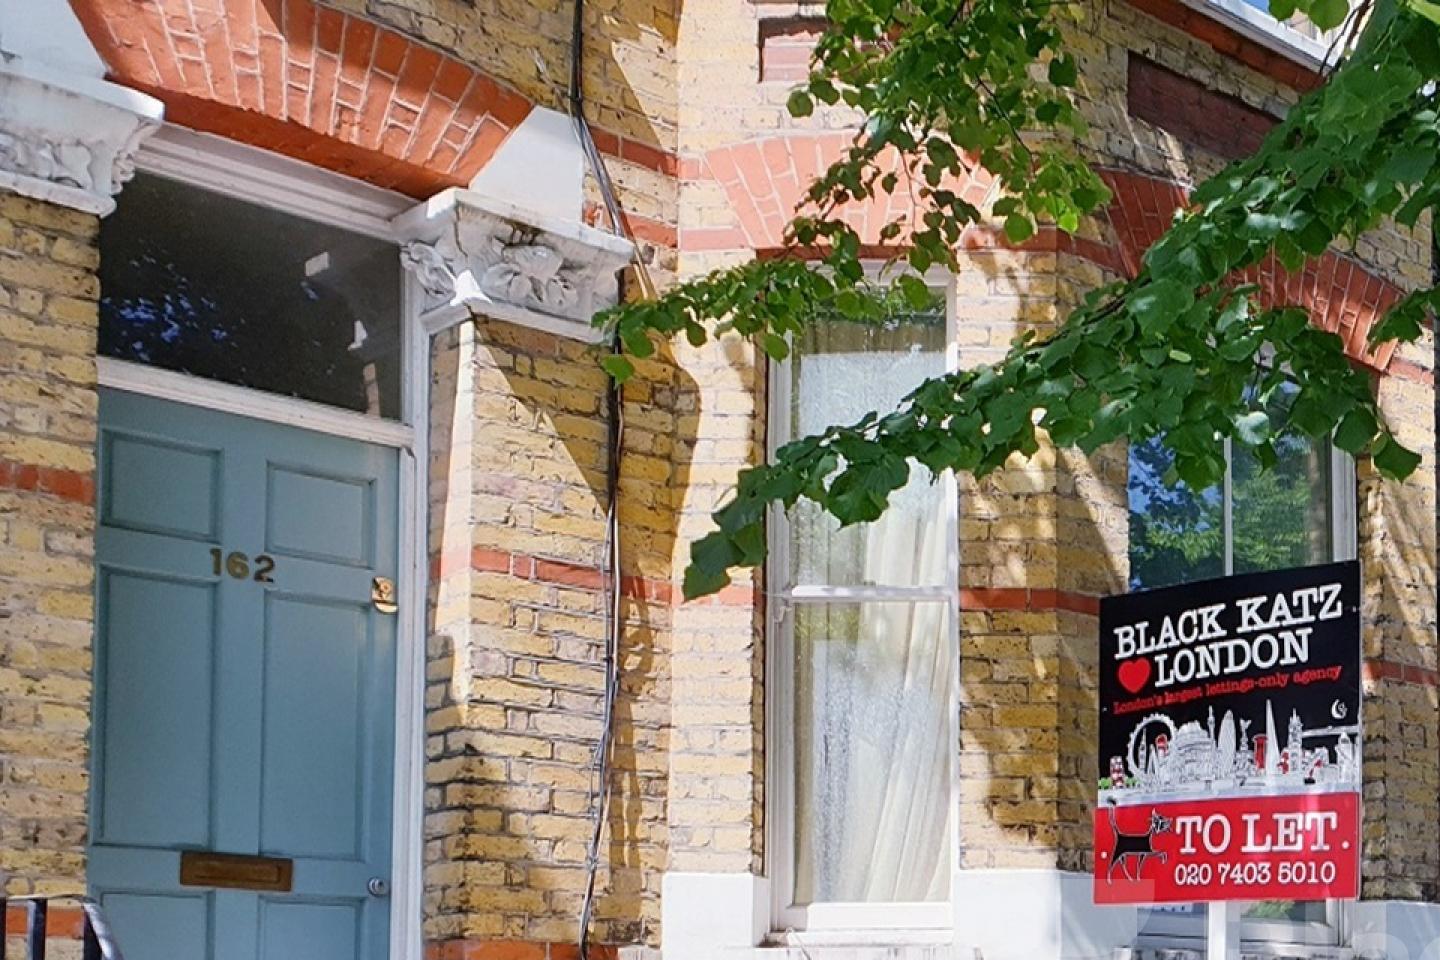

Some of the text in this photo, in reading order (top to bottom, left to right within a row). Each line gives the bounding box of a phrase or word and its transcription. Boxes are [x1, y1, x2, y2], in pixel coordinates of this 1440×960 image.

[209, 548, 275, 583] 162
[1113, 583, 1342, 660] BLACK KATZ
[1154, 627, 1313, 688] LONDON
[1293, 665, 1343, 685] agency
[1175, 811, 1337, 854] TO LET
[1174, 860, 1336, 886] 020 7403 5010
